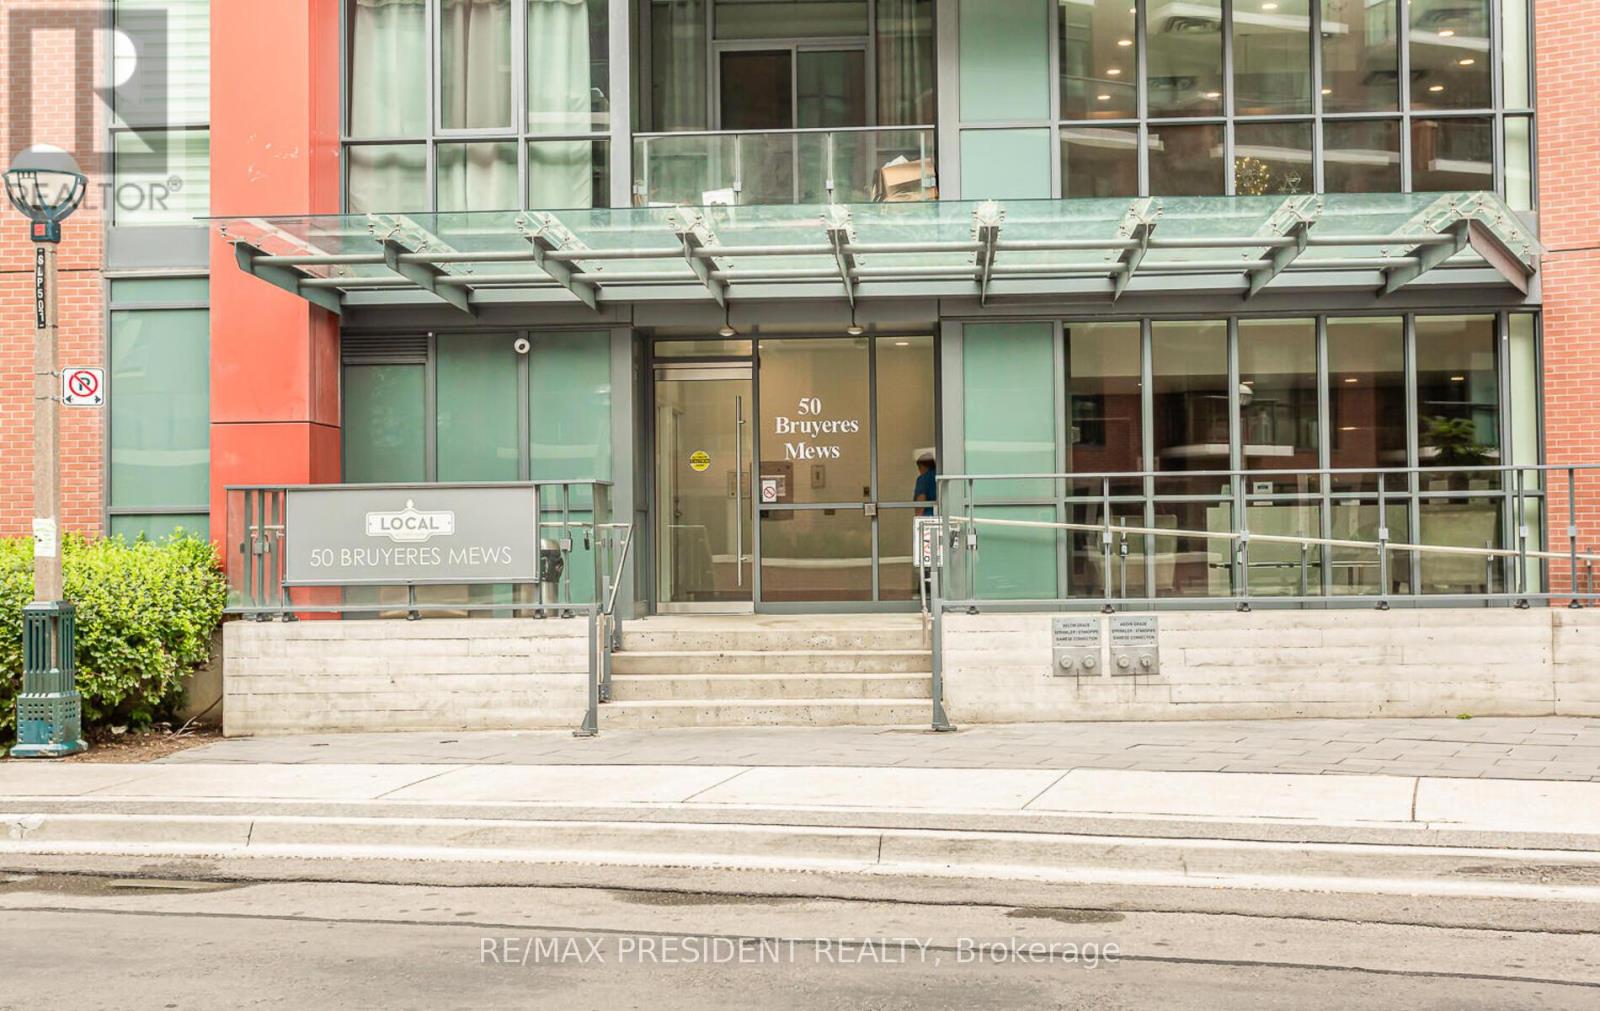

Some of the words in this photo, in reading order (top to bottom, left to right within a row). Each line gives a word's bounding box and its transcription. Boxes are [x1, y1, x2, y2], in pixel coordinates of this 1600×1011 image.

[797, 397, 822, 416] 50
[775, 416, 860, 438] Bruyeres
[784, 442, 841, 460] Mews
[380, 516, 440, 530] LOCAL
[310, 548, 335, 567] 50
[340, 547, 441, 567] BRUYERES
[448, 546, 513, 565] MEWS
